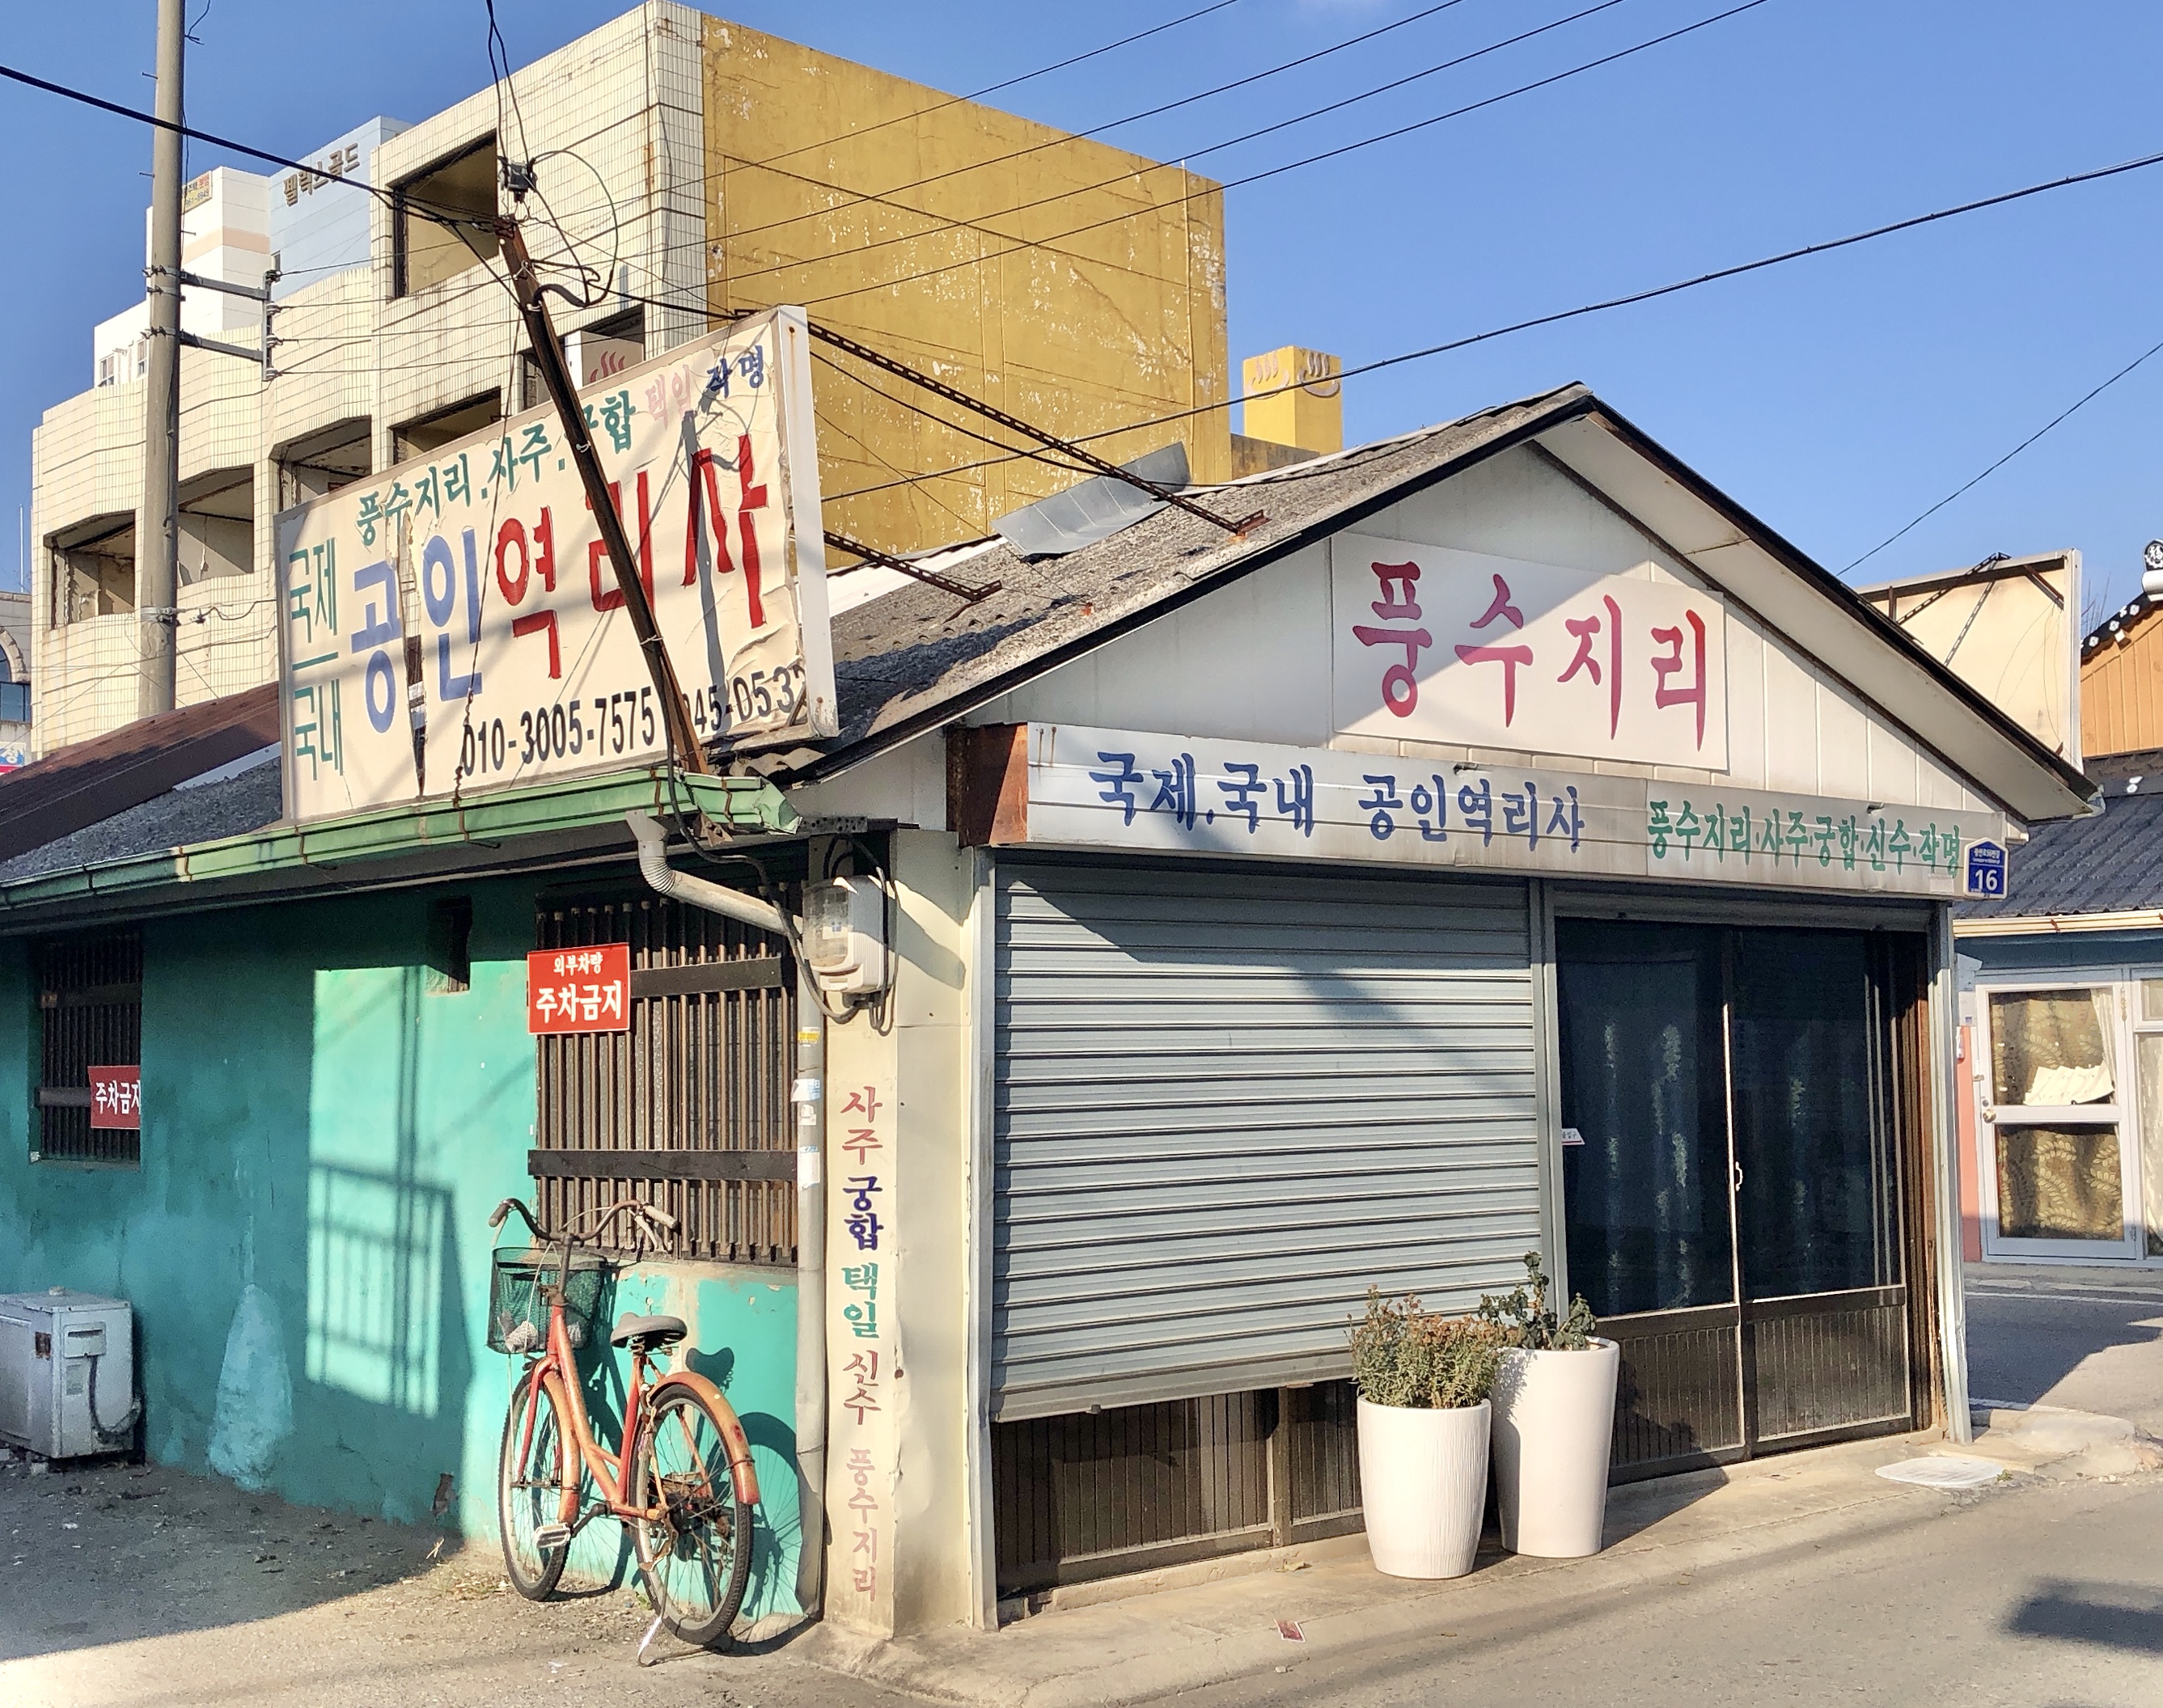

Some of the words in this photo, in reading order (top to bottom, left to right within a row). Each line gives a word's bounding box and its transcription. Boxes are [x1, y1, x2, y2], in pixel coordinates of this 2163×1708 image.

[289, 537, 338, 644] 국제
[1352, 561, 1706, 752] 풍수지리
[294, 678, 344, 781] 국내
[464, 686, 655, 776] 010-3005-7575
[1358, 774, 1585, 852] 공인역리사
[1975, 869, 1998, 891] 16
[535, 979, 621, 1024] 주차금지
[553, 951, 603, 978] 외부차량
[840, 1086, 883, 1165] 사주
[842, 1176, 884, 1251] 궁합
[846, 1448, 878, 1603] 풍수지리
